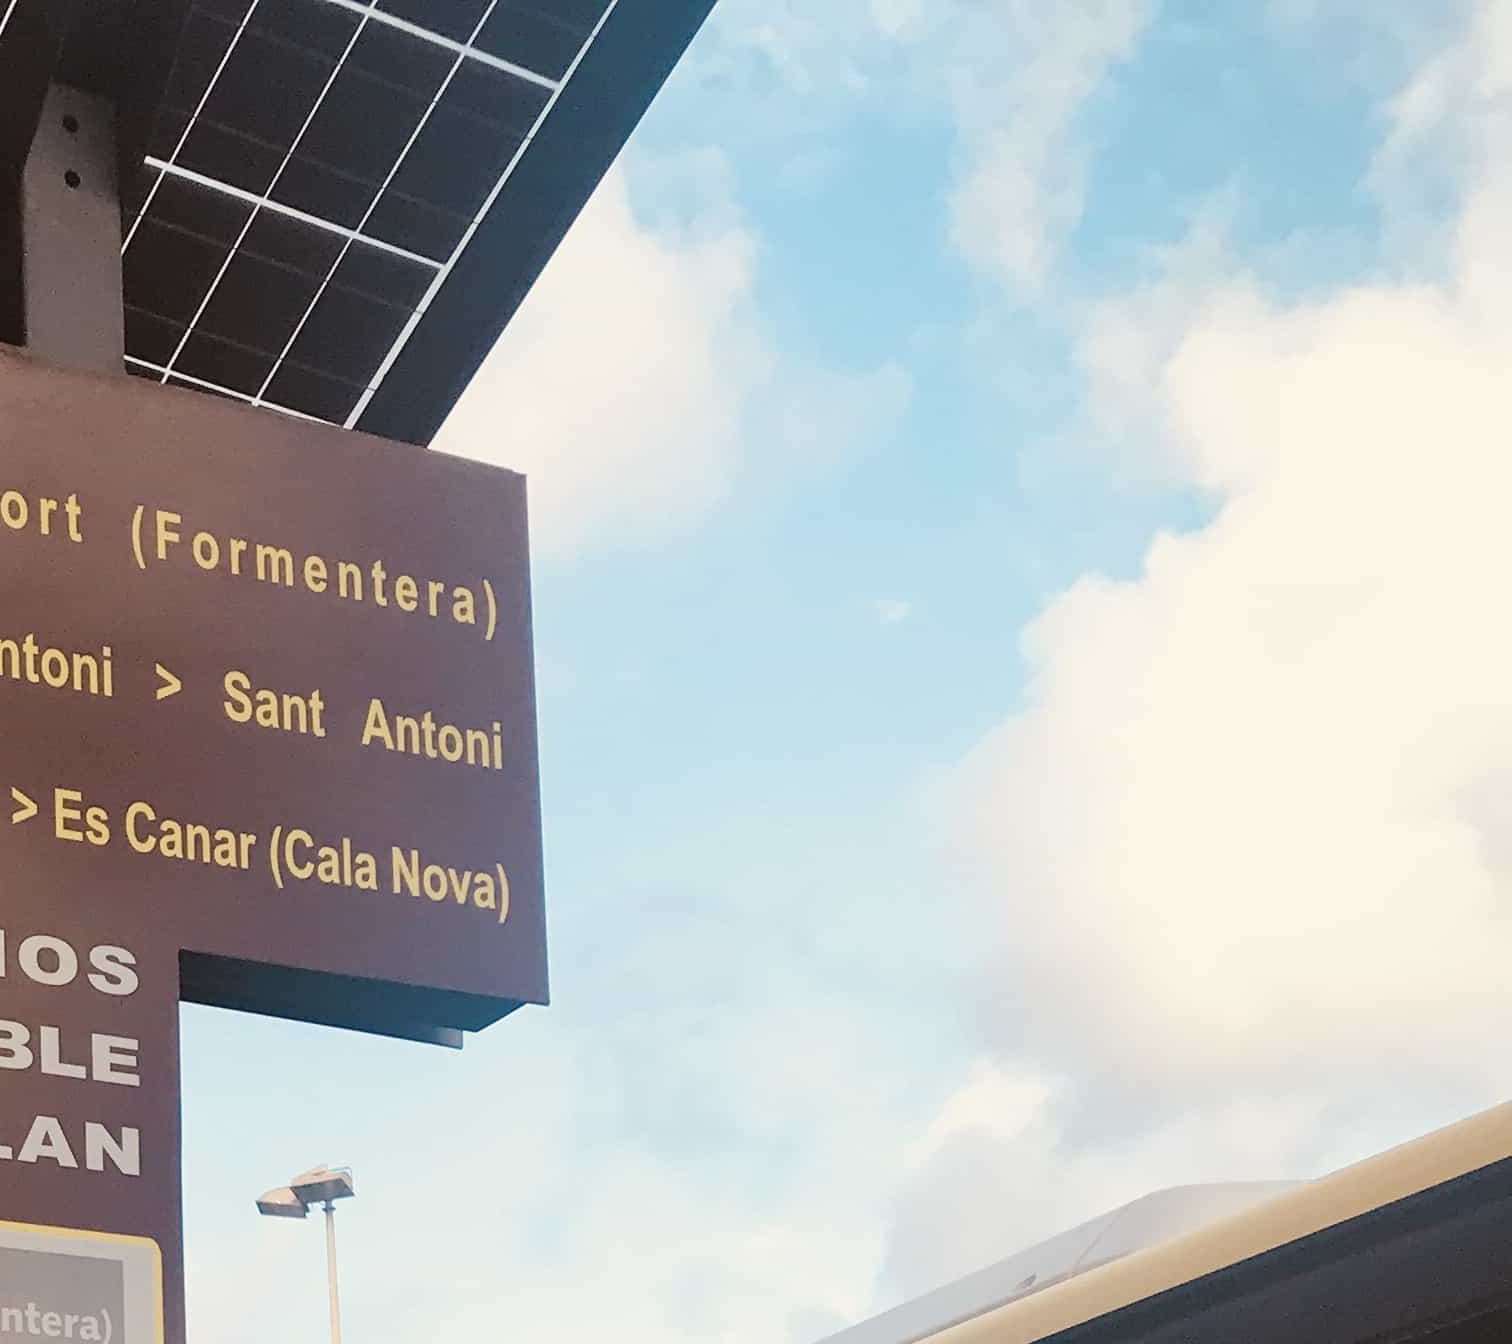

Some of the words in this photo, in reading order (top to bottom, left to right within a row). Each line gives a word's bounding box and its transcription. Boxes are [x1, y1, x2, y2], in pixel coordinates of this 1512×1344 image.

[131, 505, 498, 640] (Formentera)
[223, 672, 325, 738] Sant
[361, 698, 502, 770] Antoni
[54, 789, 110, 848] Es
[125, 802, 255, 870] Canar
[270, 825, 377, 891] (Cala
[392, 849, 510, 924] Nova)
